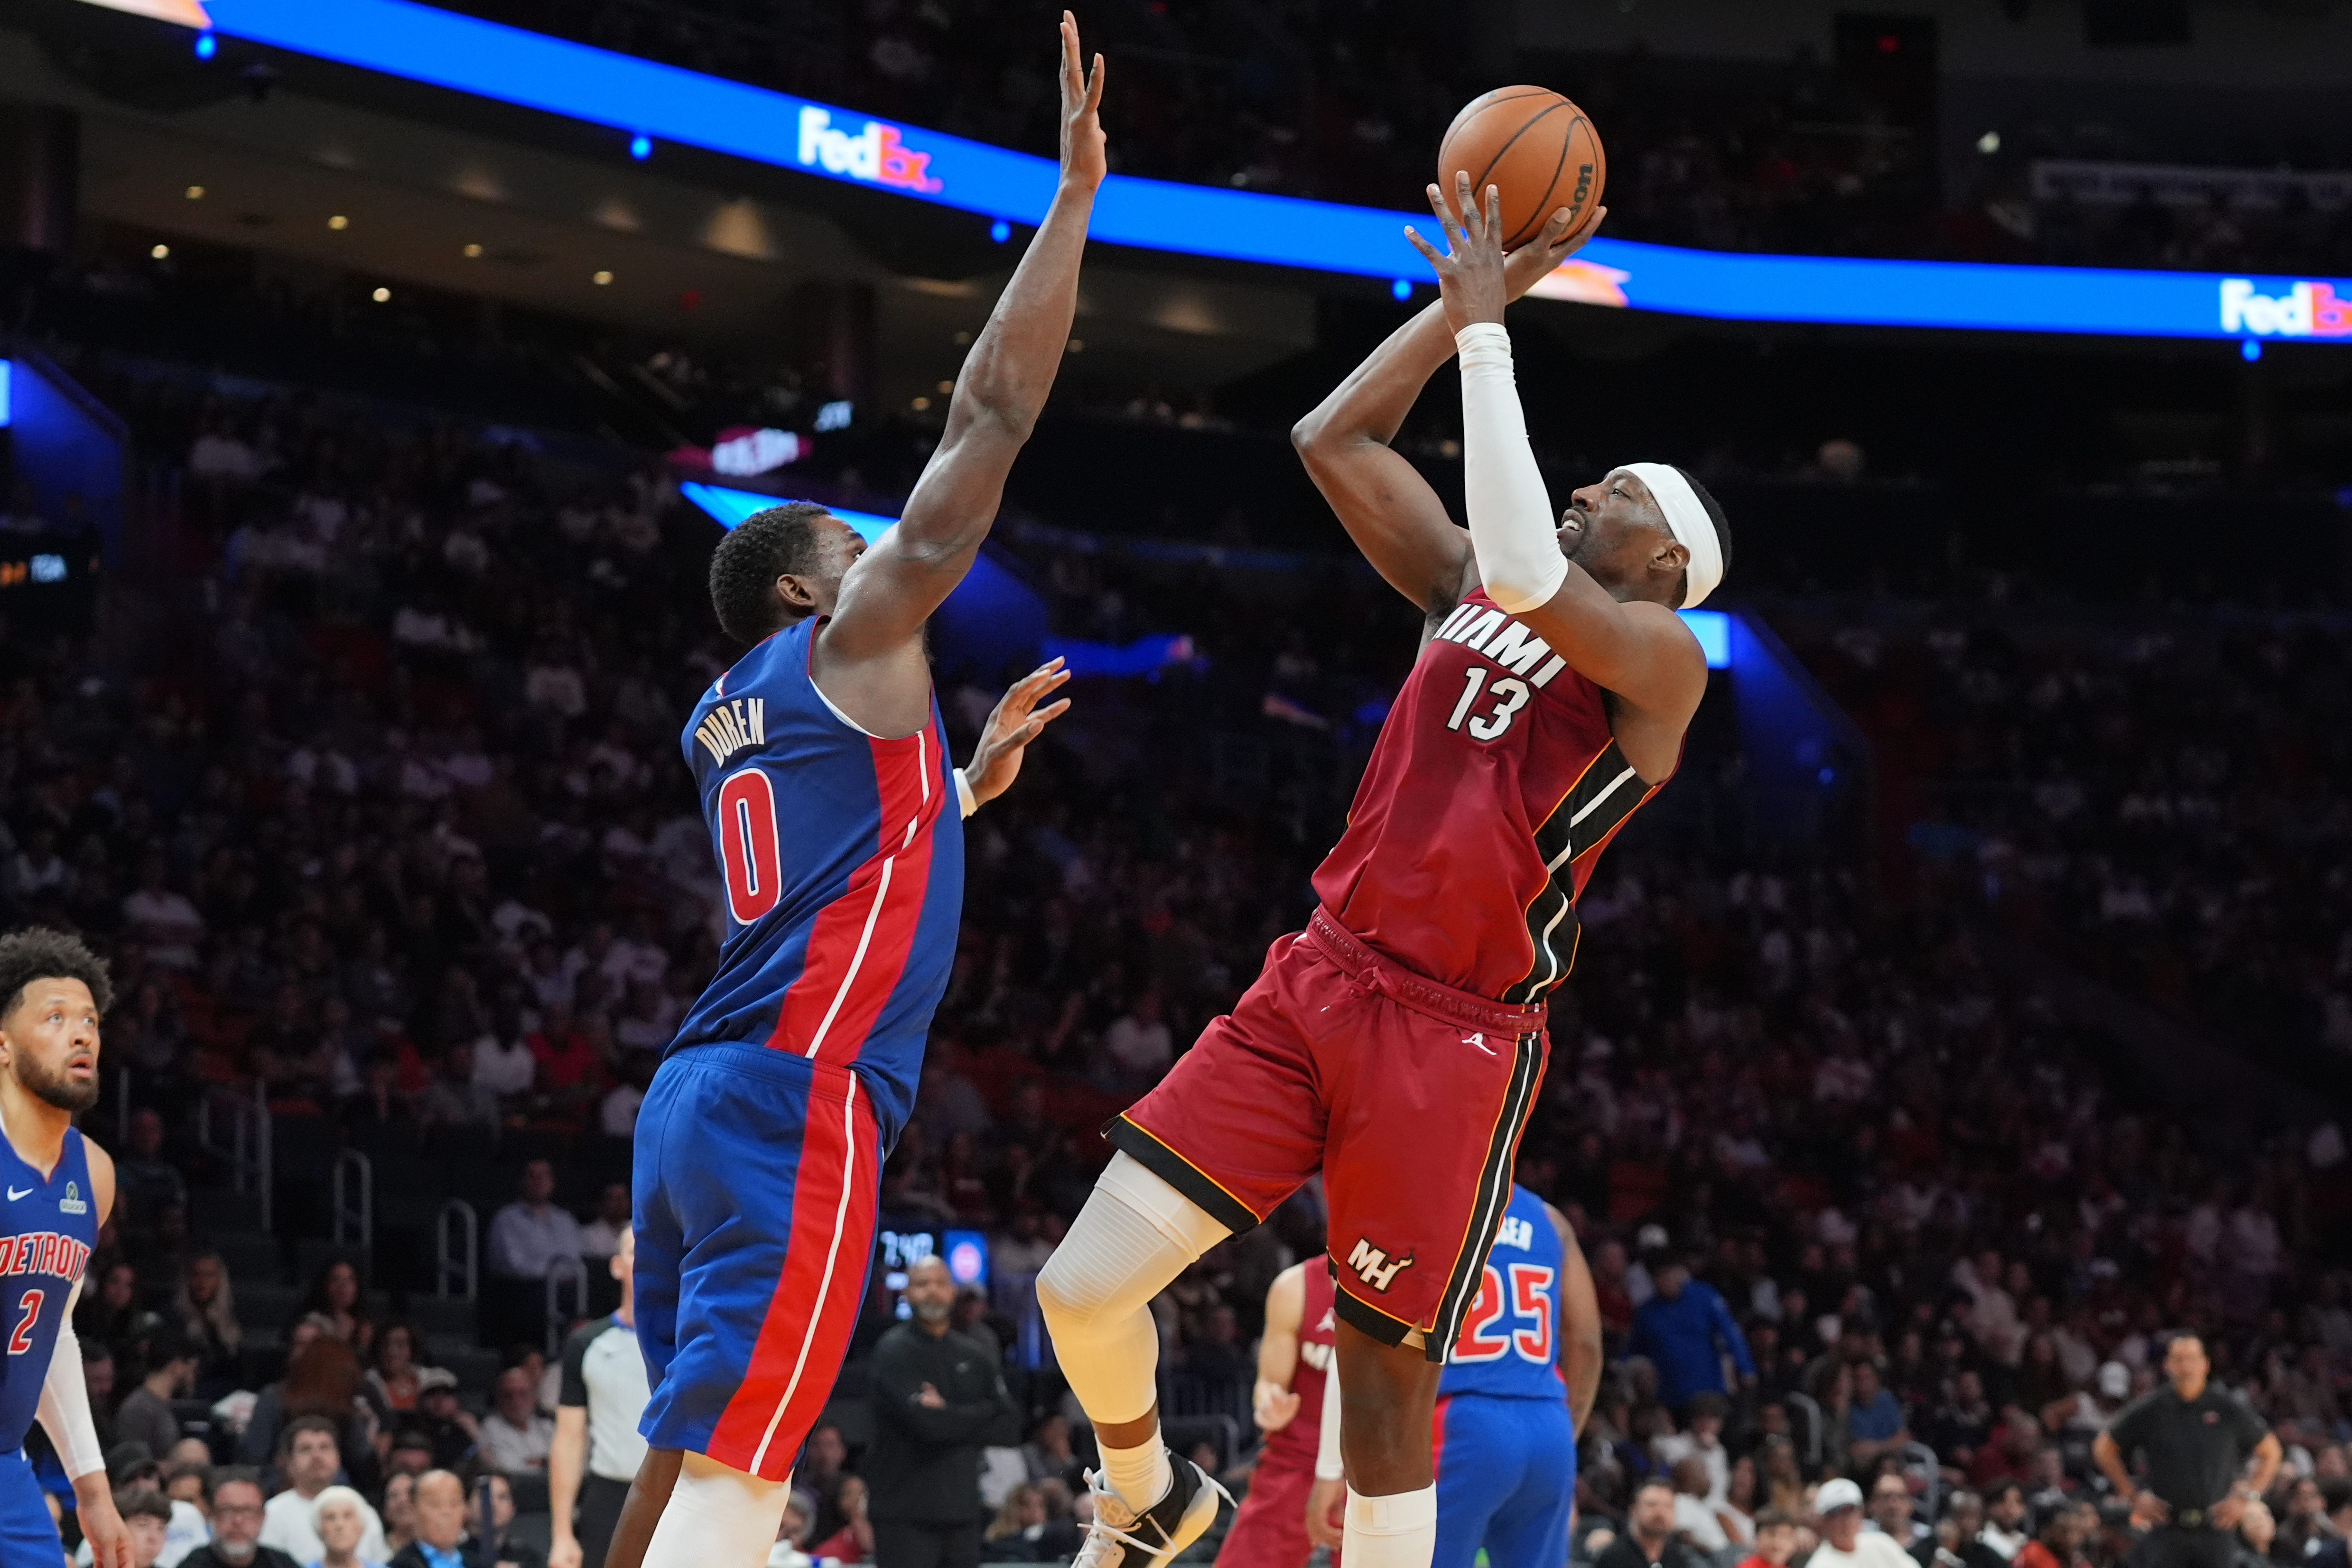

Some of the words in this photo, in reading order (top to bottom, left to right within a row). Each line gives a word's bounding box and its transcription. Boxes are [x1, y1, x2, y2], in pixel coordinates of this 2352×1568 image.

[798, 105, 933, 194] FedEx
[695, 698, 764, 768] DUREN
[1447, 667, 1531, 741] 13
[718, 768, 782, 926] 0
[1347, 1238, 1413, 1291] MH
[7, 1289, 45, 1355] 2
[1449, 1262, 1555, 1365] 25
